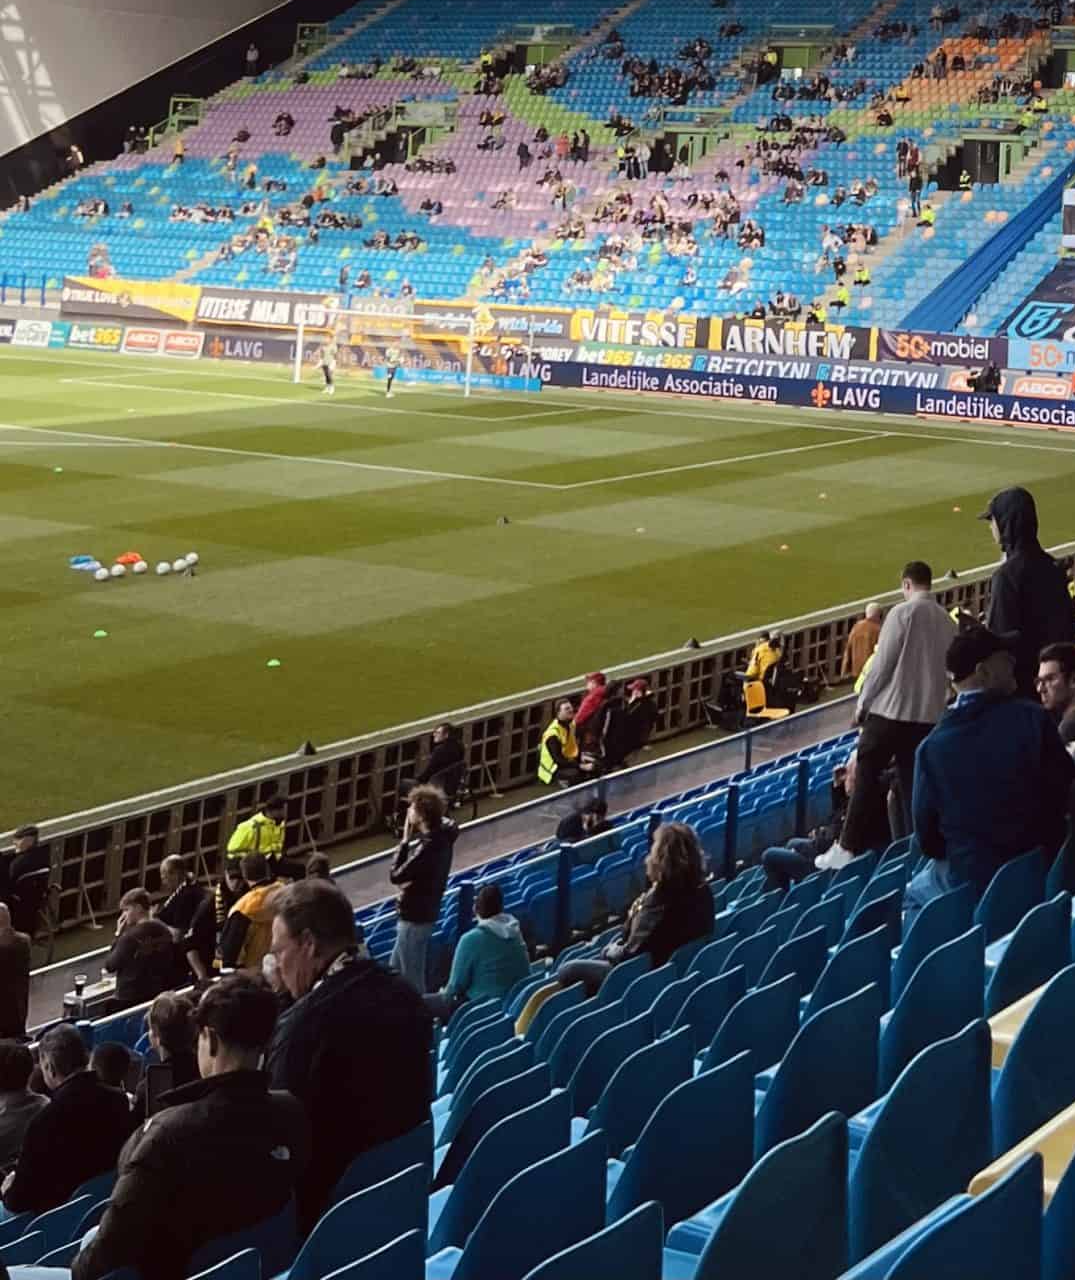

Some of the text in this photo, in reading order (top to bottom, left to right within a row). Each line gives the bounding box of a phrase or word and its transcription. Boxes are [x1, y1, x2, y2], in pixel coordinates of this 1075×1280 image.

[70, 324, 121, 345] bet365
[582, 318, 696, 348] VITESSE
[725, 324, 853, 360] ARNHEM
[225, 340, 263, 358] LAVG
[577, 345, 633, 366] bet365
[633, 350, 693, 370] bet365
[509, 362, 552, 381] LAVG
[582, 368, 777, 400] Landelijke Associatie van
[832, 386, 881, 408] LAVG
[916, 393, 1004, 421] Landelijke
